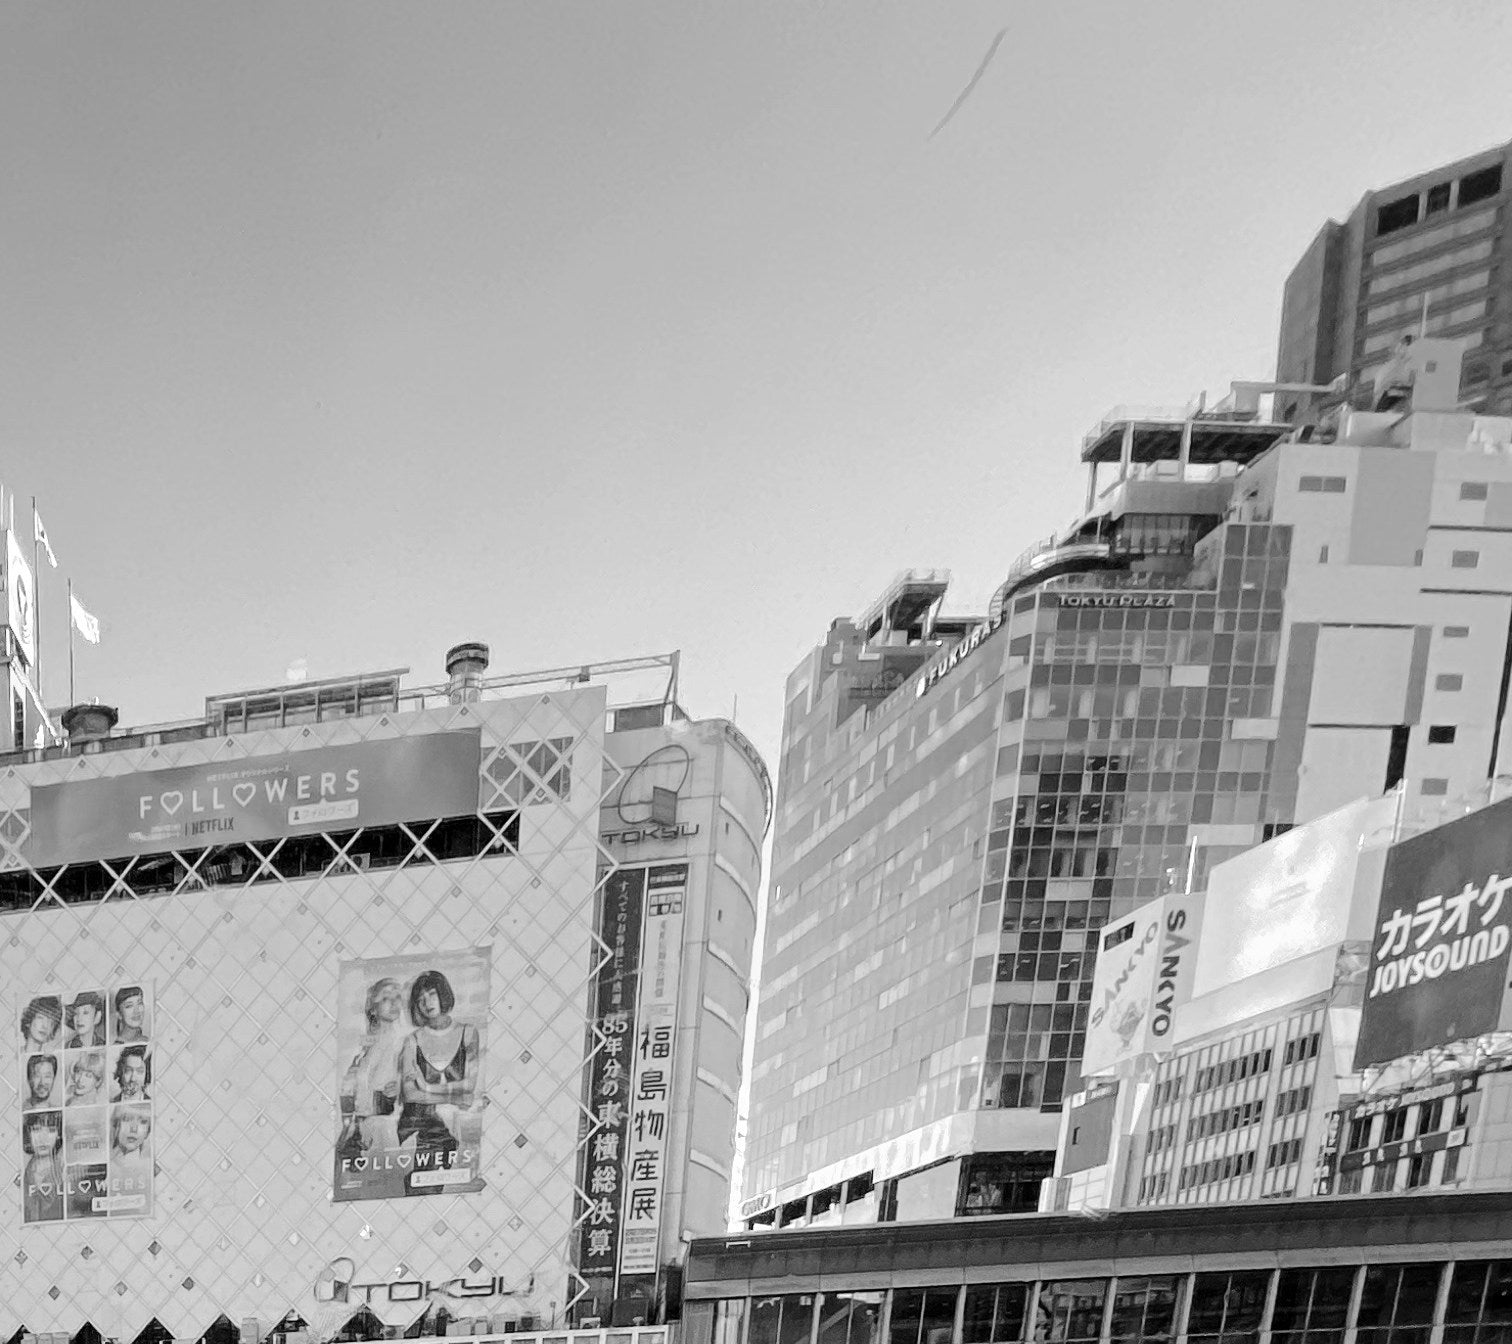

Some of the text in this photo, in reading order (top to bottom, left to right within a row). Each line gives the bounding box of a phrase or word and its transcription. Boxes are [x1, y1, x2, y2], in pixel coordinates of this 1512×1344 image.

[1058, 593, 1176, 608] TOKYU PLAZA
[192, 817, 235, 836] NETFLIX
[601, 824, 699, 845] TOKYU
[1376, 874, 1512, 961] カラオケ
[1151, 909, 1191, 1037] SANKYO
[1369, 924, 1510, 999] JOYSOUND
[630, 1022, 672, 1221] 福島物産展
[351, 1276, 535, 1303] TOKYU
